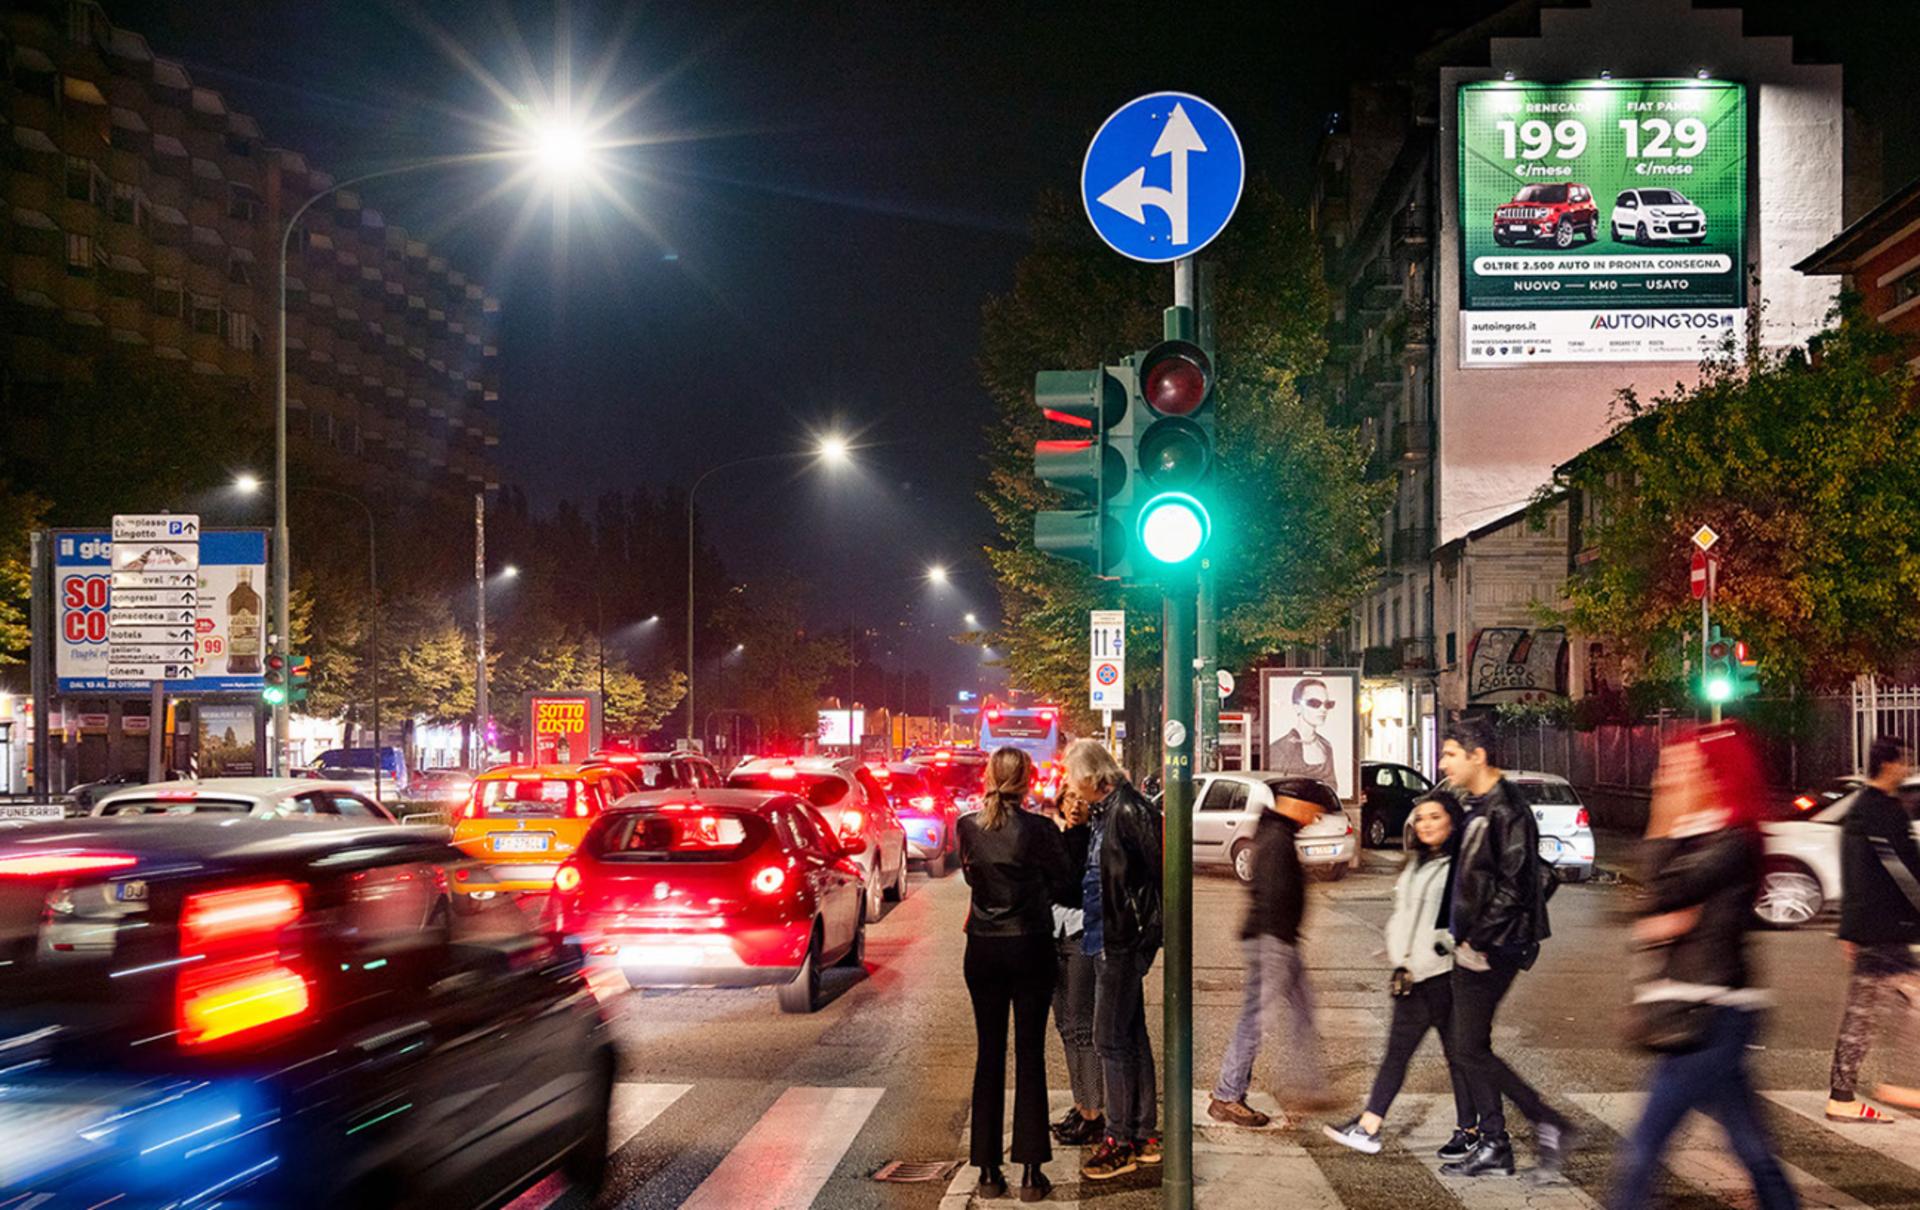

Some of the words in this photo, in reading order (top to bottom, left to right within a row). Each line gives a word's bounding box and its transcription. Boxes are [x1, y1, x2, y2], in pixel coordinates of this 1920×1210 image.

[1526, 103, 1591, 113] RENEGAD
[1627, 102, 1653, 111] FIAT
[1496, 119, 1588, 160] 199
[1618, 118, 1708, 159] 129
[1515, 163, 1572, 177] €/mese
[1635, 161, 1693, 175] €/mese
[1482, 261, 1520, 271] OLTRE
[1522, 261, 1555, 271] 2.500
[1558, 261, 1590, 270] AUTO
[1593, 261, 1605, 269] IN
[1609, 260, 1655, 269] PRONTA
[1657, 259, 1721, 269] CONSEGNA
[1514, 281, 1561, 291] NUOVO
[1645, 280, 1689, 290] USATO
[1471, 322, 1536, 332] autoingros.it
[115, 518, 167, 527] cplesso
[115, 529, 157, 539] Lingotto
[61, 538, 74, 556] il
[143, 576, 163, 585] oval
[66, 577, 112, 608] SO
[112, 594, 158, 603] congressi
[111, 612, 164, 621] pinacoteca
[110, 630, 142, 639] hotels
[110, 666, 144, 675] cinema
[538, 703, 585, 718] SOTTO
[537, 718, 585, 733] COSTO
[0, 806, 60, 817] FUNERARIA
